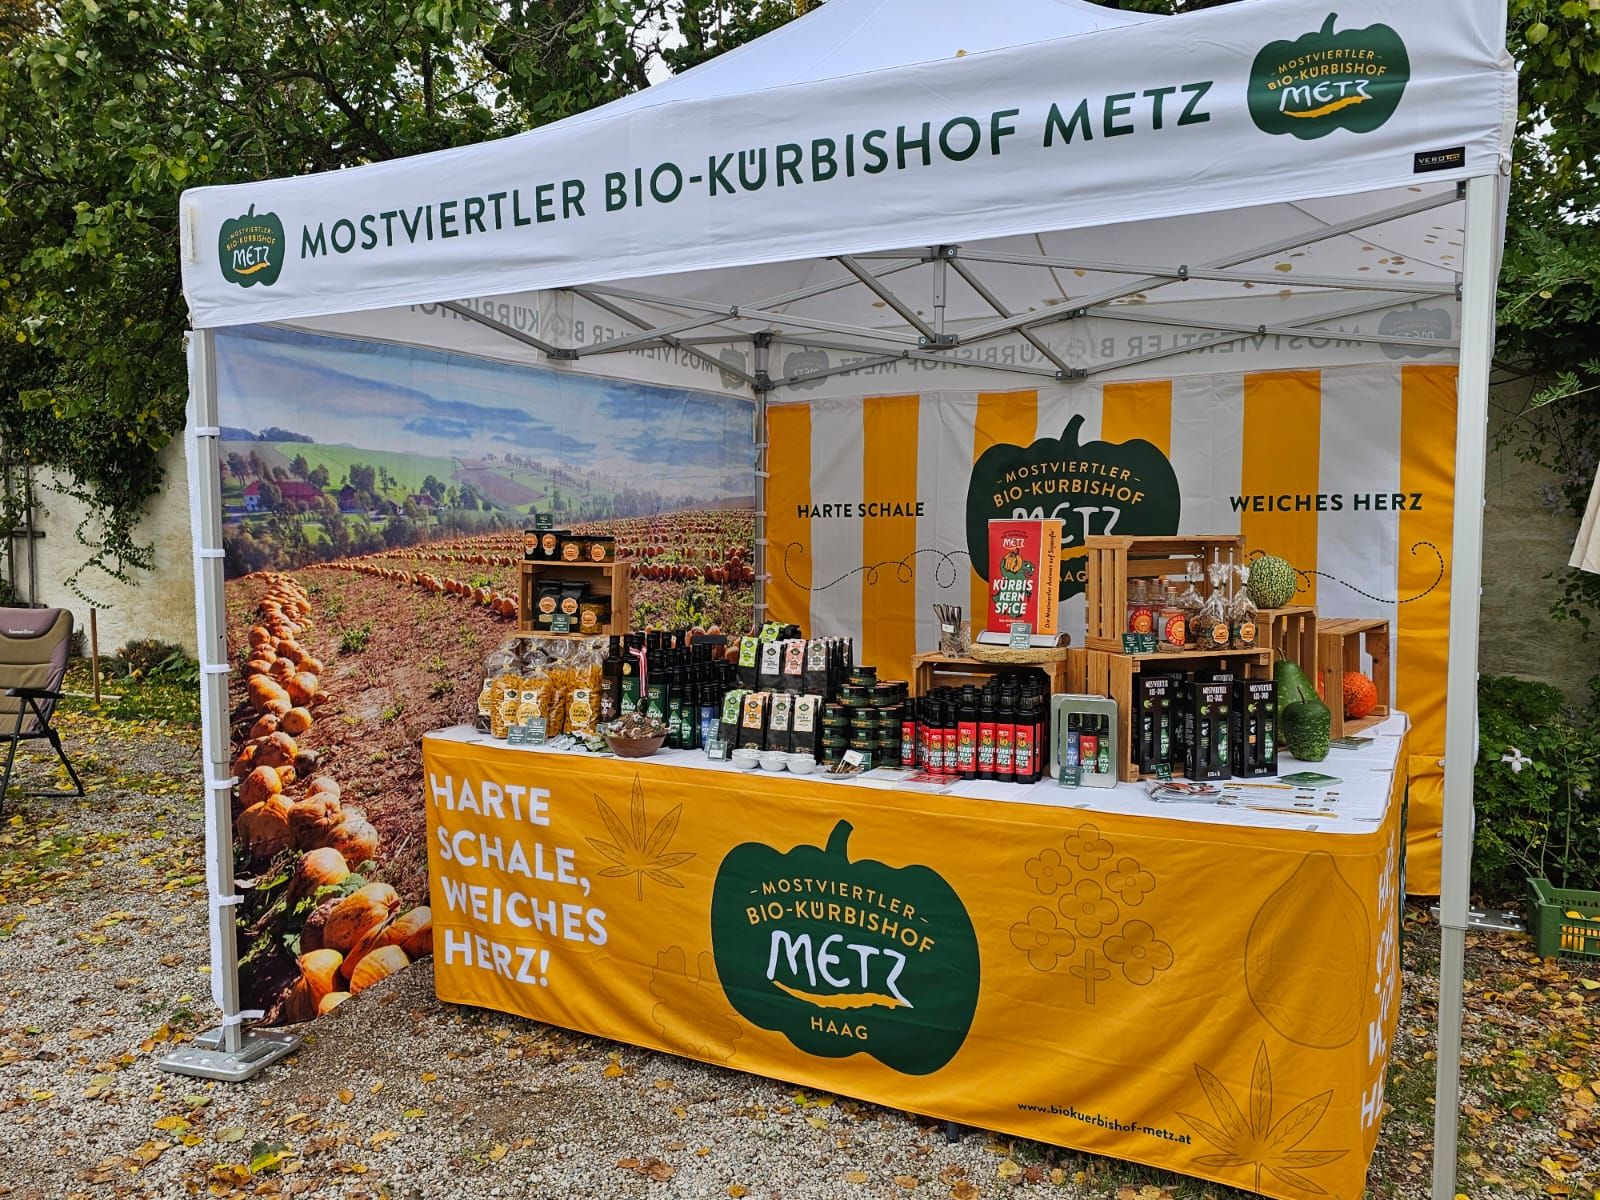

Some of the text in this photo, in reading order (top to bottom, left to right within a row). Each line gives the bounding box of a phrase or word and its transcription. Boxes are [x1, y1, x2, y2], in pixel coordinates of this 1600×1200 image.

[1278, 49, 1375, 74] MOSTVIERTLER
[1267, 62, 1387, 91] BIO-KÜRBISHOF
[1279, 79, 1373, 112] METZ
[301, 81, 1213, 259] MOSTVIERTLER BIO-KÜRBISHOF METZ
[230, 226, 271, 240] MOSTVIERTLER
[232, 245, 271, 269] METZ
[1005, 461, 1131, 483] MOSTVIERTLER
[993, 479, 1145, 507] BIO-KÜRBISHOF
[1230, 493, 1423, 512] WEICHES HERZ
[798, 502, 924, 518] HARTE SCHALE
[1003, 537, 1025, 548] METZ
[992, 577, 1034, 591] KÜRBIS
[999, 591, 1025, 602] KERN
[429, 773, 550, 826] HARTE
[437, 825, 591, 897] SCHALE,
[440, 876, 608, 946] WEICHES
[762, 878, 916, 920] MOSTVIERTLER
[745, 901, 935, 953] BIO-KÜRBISHOF
[444, 929, 550, 987] HERZ!
[766, 929, 914, 1009] METZ
[810, 1016, 869, 1040] HAAG
[1018, 1103, 1192, 1144] www.biokuerbishof-metz.at
